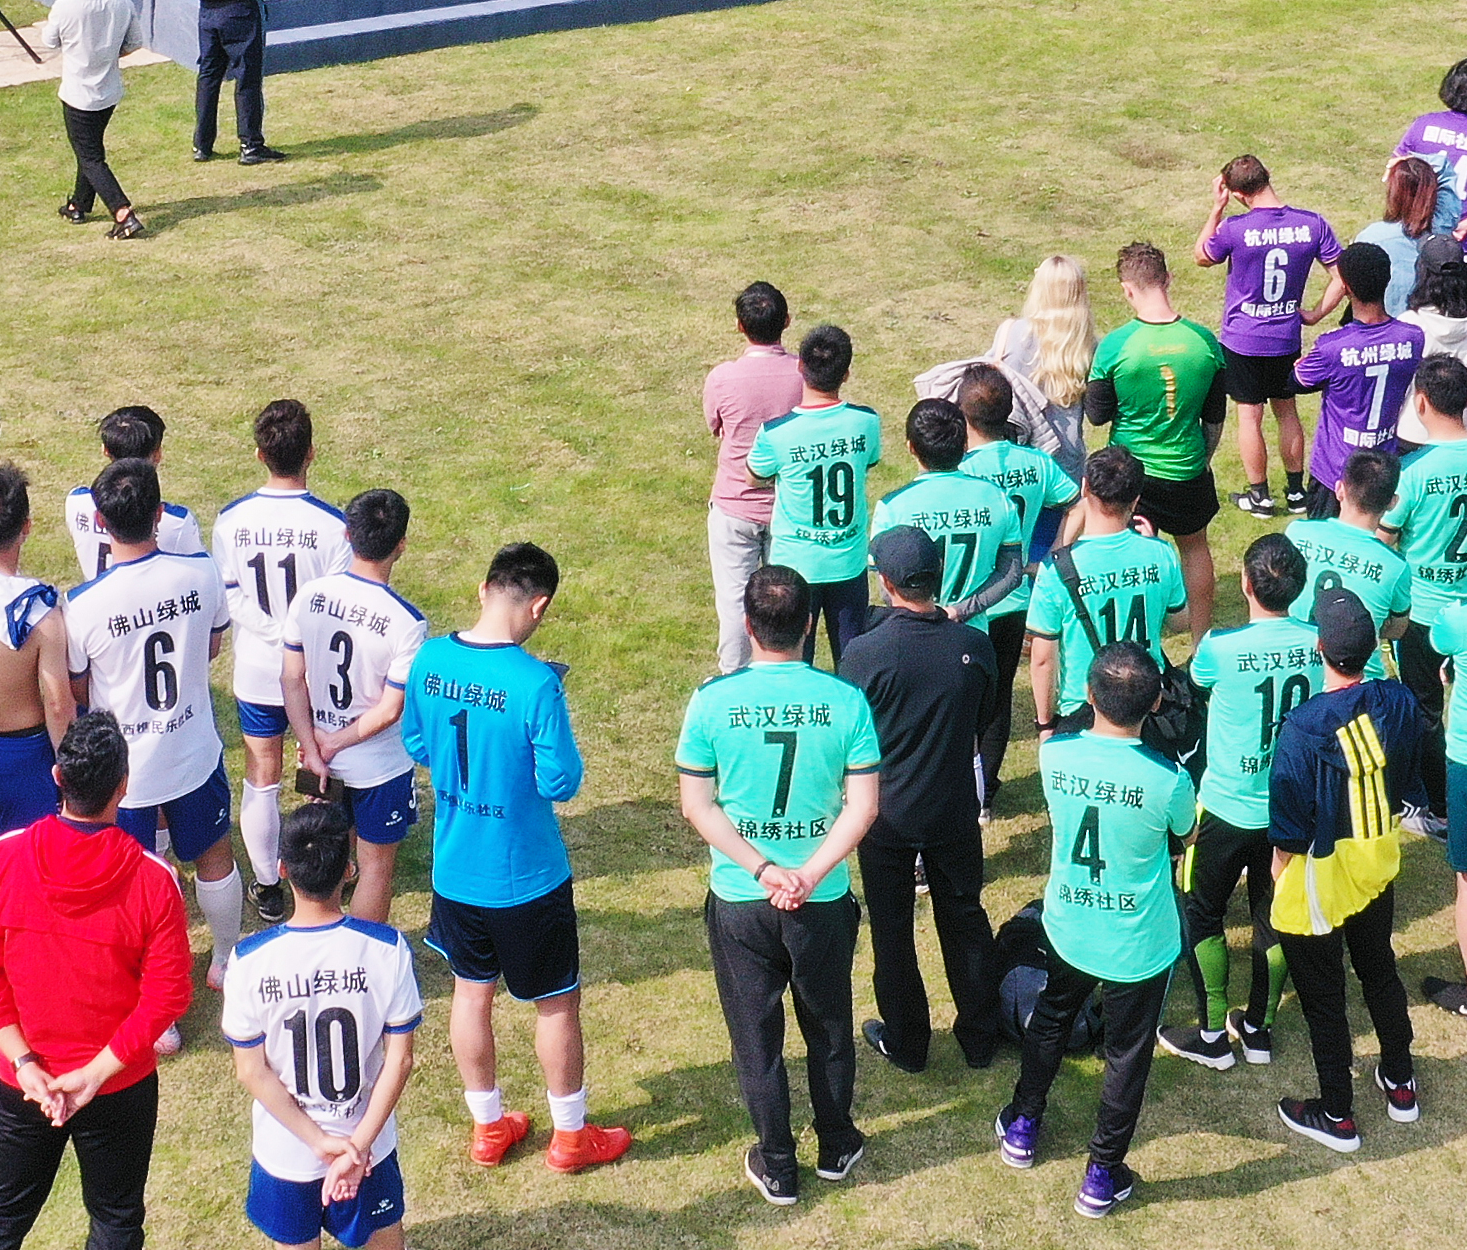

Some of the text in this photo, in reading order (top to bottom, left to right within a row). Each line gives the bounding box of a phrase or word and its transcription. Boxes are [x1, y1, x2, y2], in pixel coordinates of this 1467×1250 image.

[1244, 225, 1312, 246] 杭州绿城
[1263, 248, 1288, 302] 6
[1241, 300, 1297, 317] 国际社区
[1341, 341, 1412, 367] 杭州绿城
[1365, 363, 1390, 430] 7
[789, 434, 866, 463] 武汉绿城
[806, 461, 854, 528] 19
[983, 466, 1039, 489] 汉绿城
[234, 527, 318, 550] 佛山绿城
[911, 507, 992, 531] 武汉绿城
[1078, 563, 1160, 597] 武汉绿城
[1295, 538, 1384, 584] 武汉绿城
[247, 552, 298, 618] 11
[108, 590, 202, 638] 佛山绿城
[309, 592, 391, 637] 佛山绿城
[1098, 594, 1151, 649] 14
[144, 630, 177, 711] 6
[329, 630, 354, 710] 3
[1237, 648, 1323, 673] 武汉绿城
[423, 671, 508, 713] 佛山绿城
[728, 702, 831, 729] 武汉绿城
[449, 709, 469, 795] 1
[764, 731, 797, 819] 7
[1051, 770, 1144, 809] 武汉绿城
[736, 817, 828, 840] 锦绣社区
[1071, 805, 1106, 887] 4
[1059, 883, 1137, 911] 锦绣社区
[258, 966, 368, 1003] 佛山绿城
[284, 1007, 360, 1102] 10
